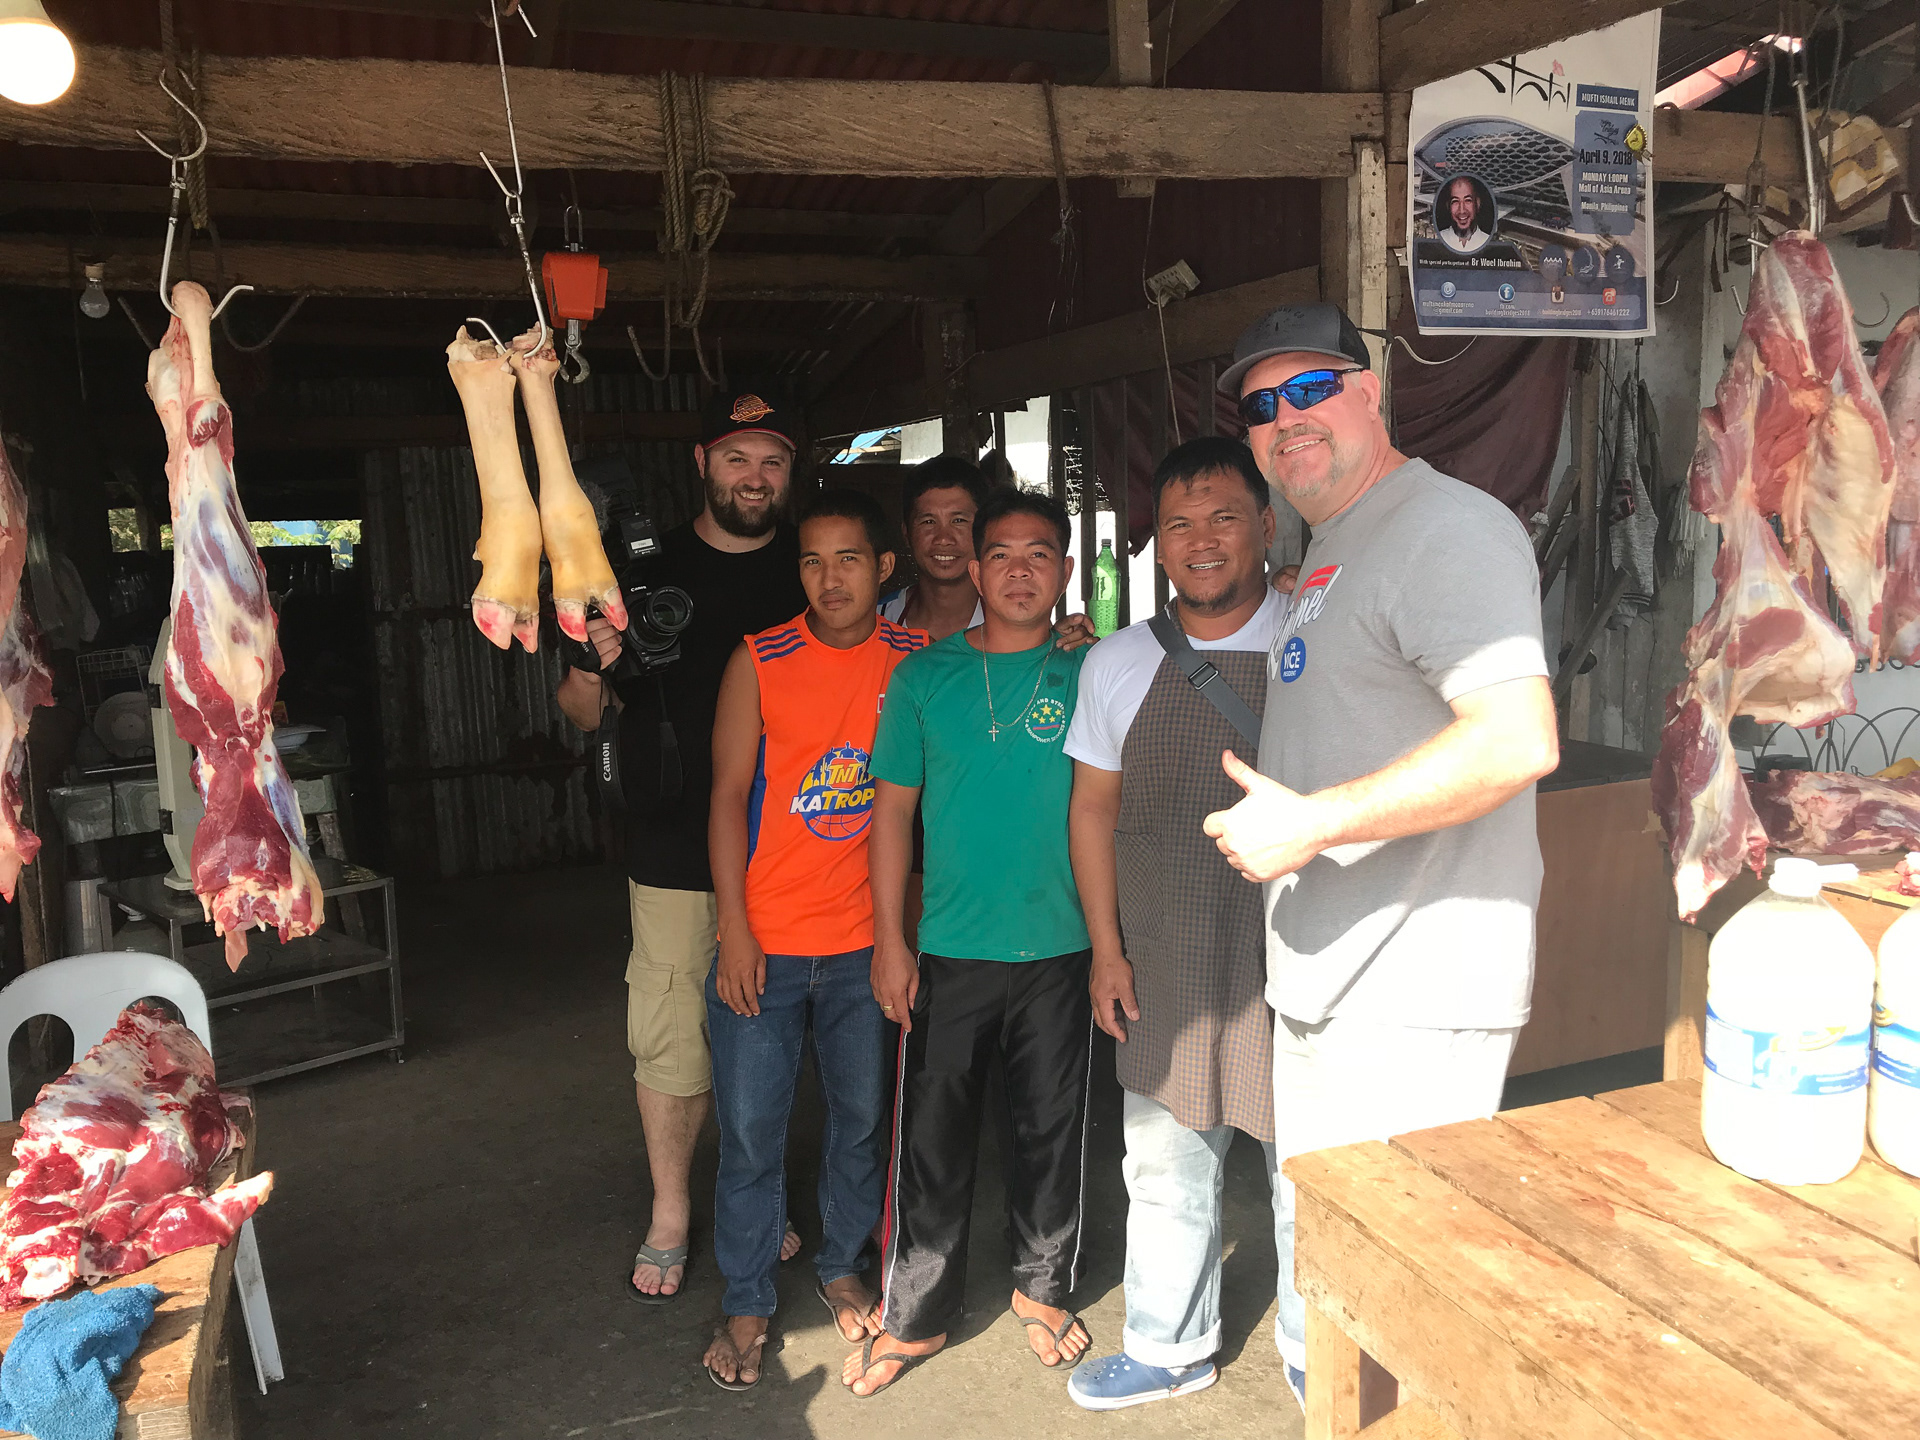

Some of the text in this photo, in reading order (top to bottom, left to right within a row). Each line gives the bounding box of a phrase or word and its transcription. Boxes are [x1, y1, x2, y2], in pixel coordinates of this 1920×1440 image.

[1581, 93, 1635, 106] MUFTI ISMAIL MENK
[1579, 149, 1633, 165] April 9, 2018
[1582, 172, 1629, 183] MONDAY 1:00PM
[1579, 183, 1631, 195] Mall of Asia Arena
[1600, 202, 1628, 212] Philippines
[1471, 258, 1479, 266] Br
[1480, 258, 1495, 267] Wael
[1497, 258, 1521, 268] Ibrahim
[1036, 697, 1049, 705] AND
[602, 741, 613, 782] Canon
[827, 762, 863, 785] TNT
[789, 787, 875, 814] KATROP
